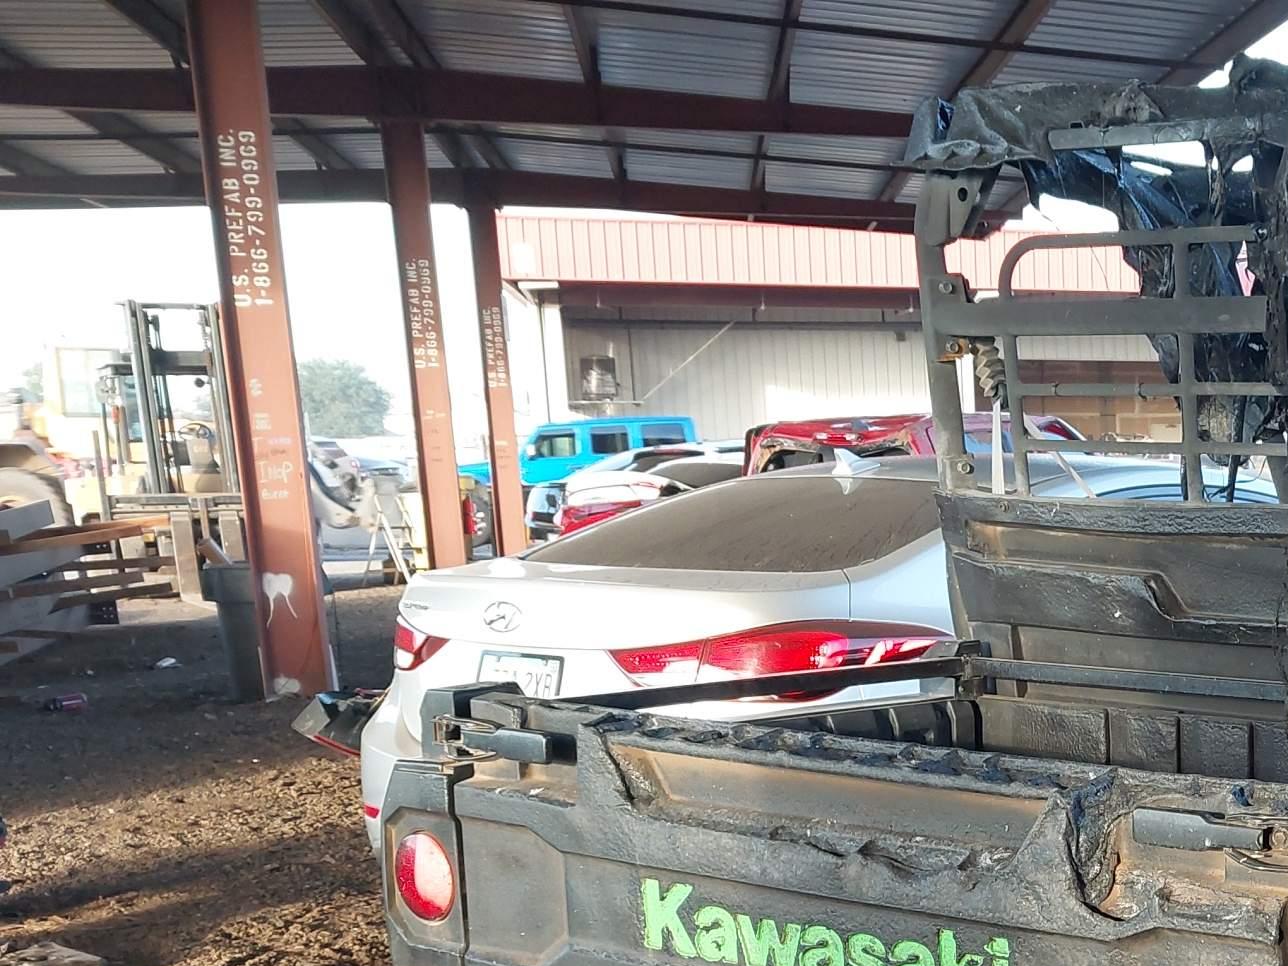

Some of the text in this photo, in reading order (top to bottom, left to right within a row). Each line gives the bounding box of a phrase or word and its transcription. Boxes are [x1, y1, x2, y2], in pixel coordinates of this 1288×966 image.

[217, 129, 251, 307] U.S. PREFAB INC.
[238, 130, 273, 306] 1-866-799-0969
[405, 257, 425, 369] U.S. PREFAB INC.
